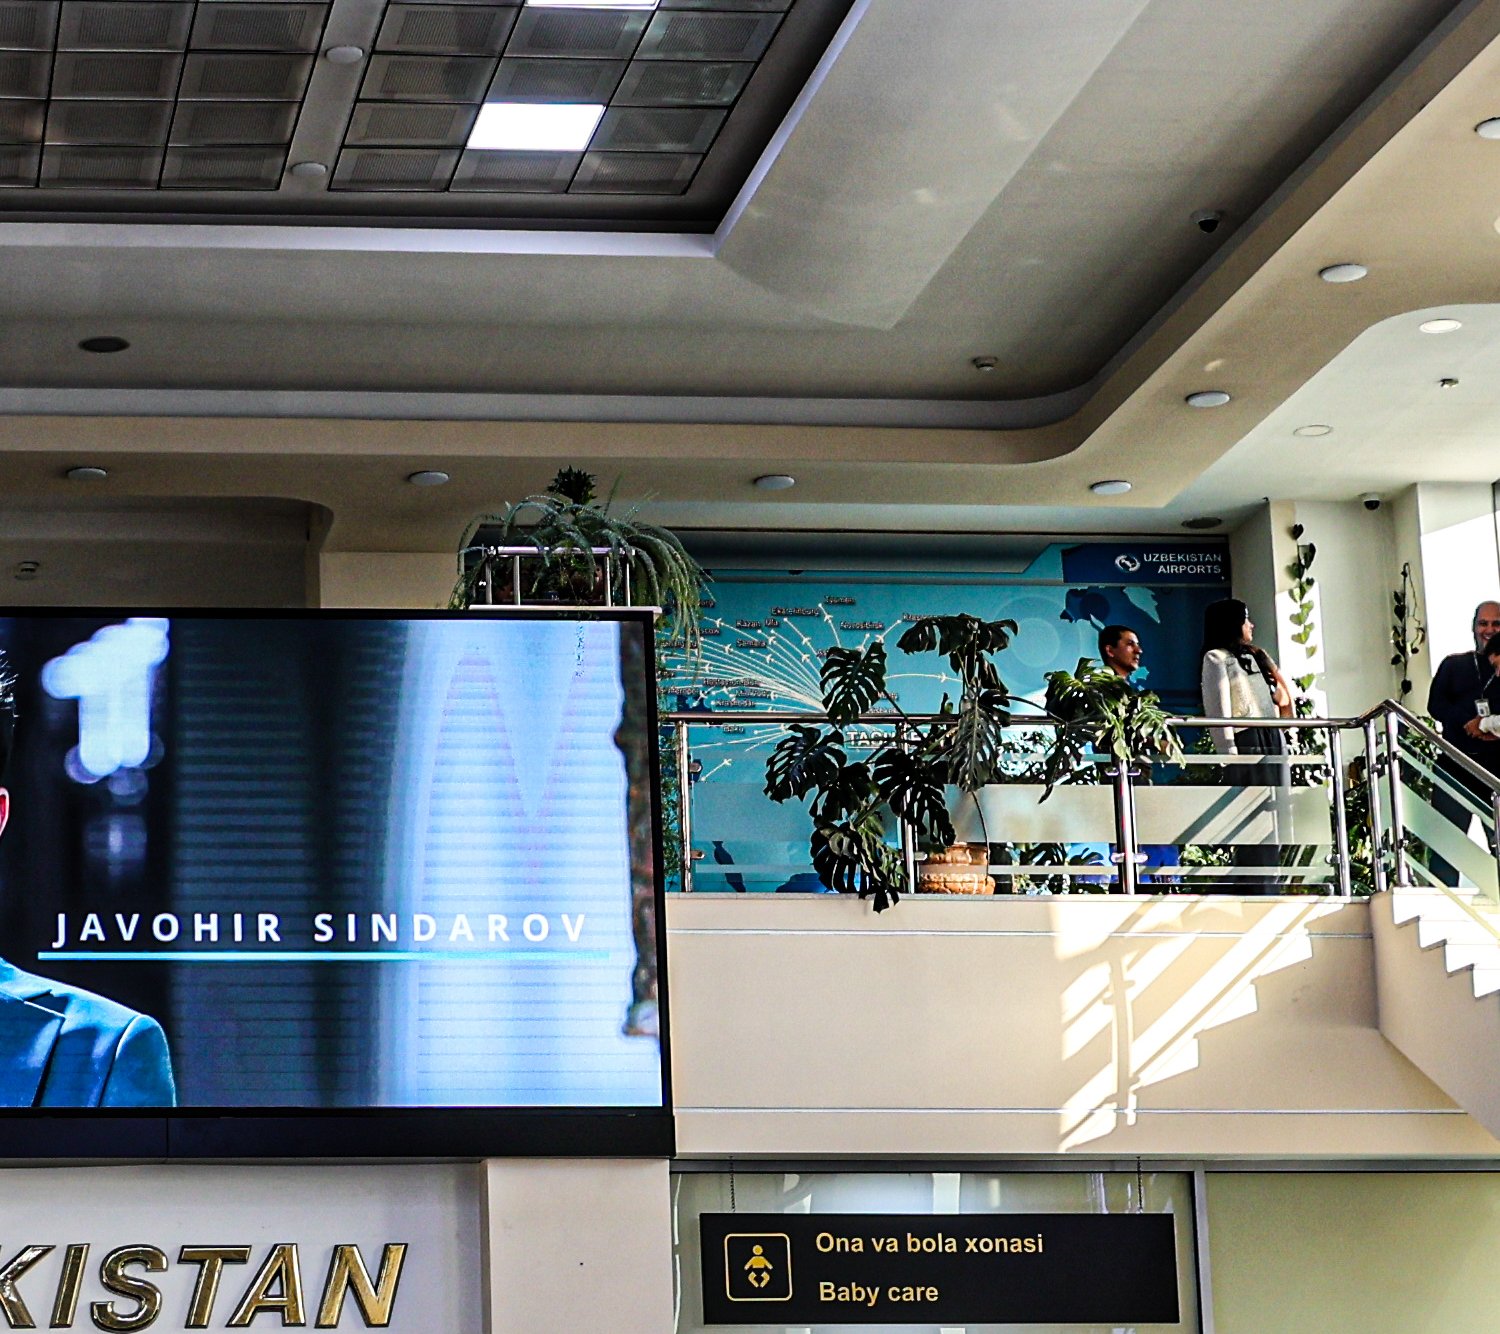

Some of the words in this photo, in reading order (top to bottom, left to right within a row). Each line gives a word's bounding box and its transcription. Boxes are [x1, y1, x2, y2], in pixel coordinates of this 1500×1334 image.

[1143, 553, 1222, 563] UZBEKISTAN
[1157, 565, 1222, 574] AIRPORTS
[52, 913, 284, 946] JAVOHIR
[312, 913, 591, 943] SINDAROV
[815, 1232, 864, 1253] Ona
[871, 1237, 899, 1253] va
[906, 1232, 957, 1253] bola
[964, 1233, 1044, 1253] xonasi
[819, 1281, 880, 1307] Baby
[887, 1285, 939, 1302] care
